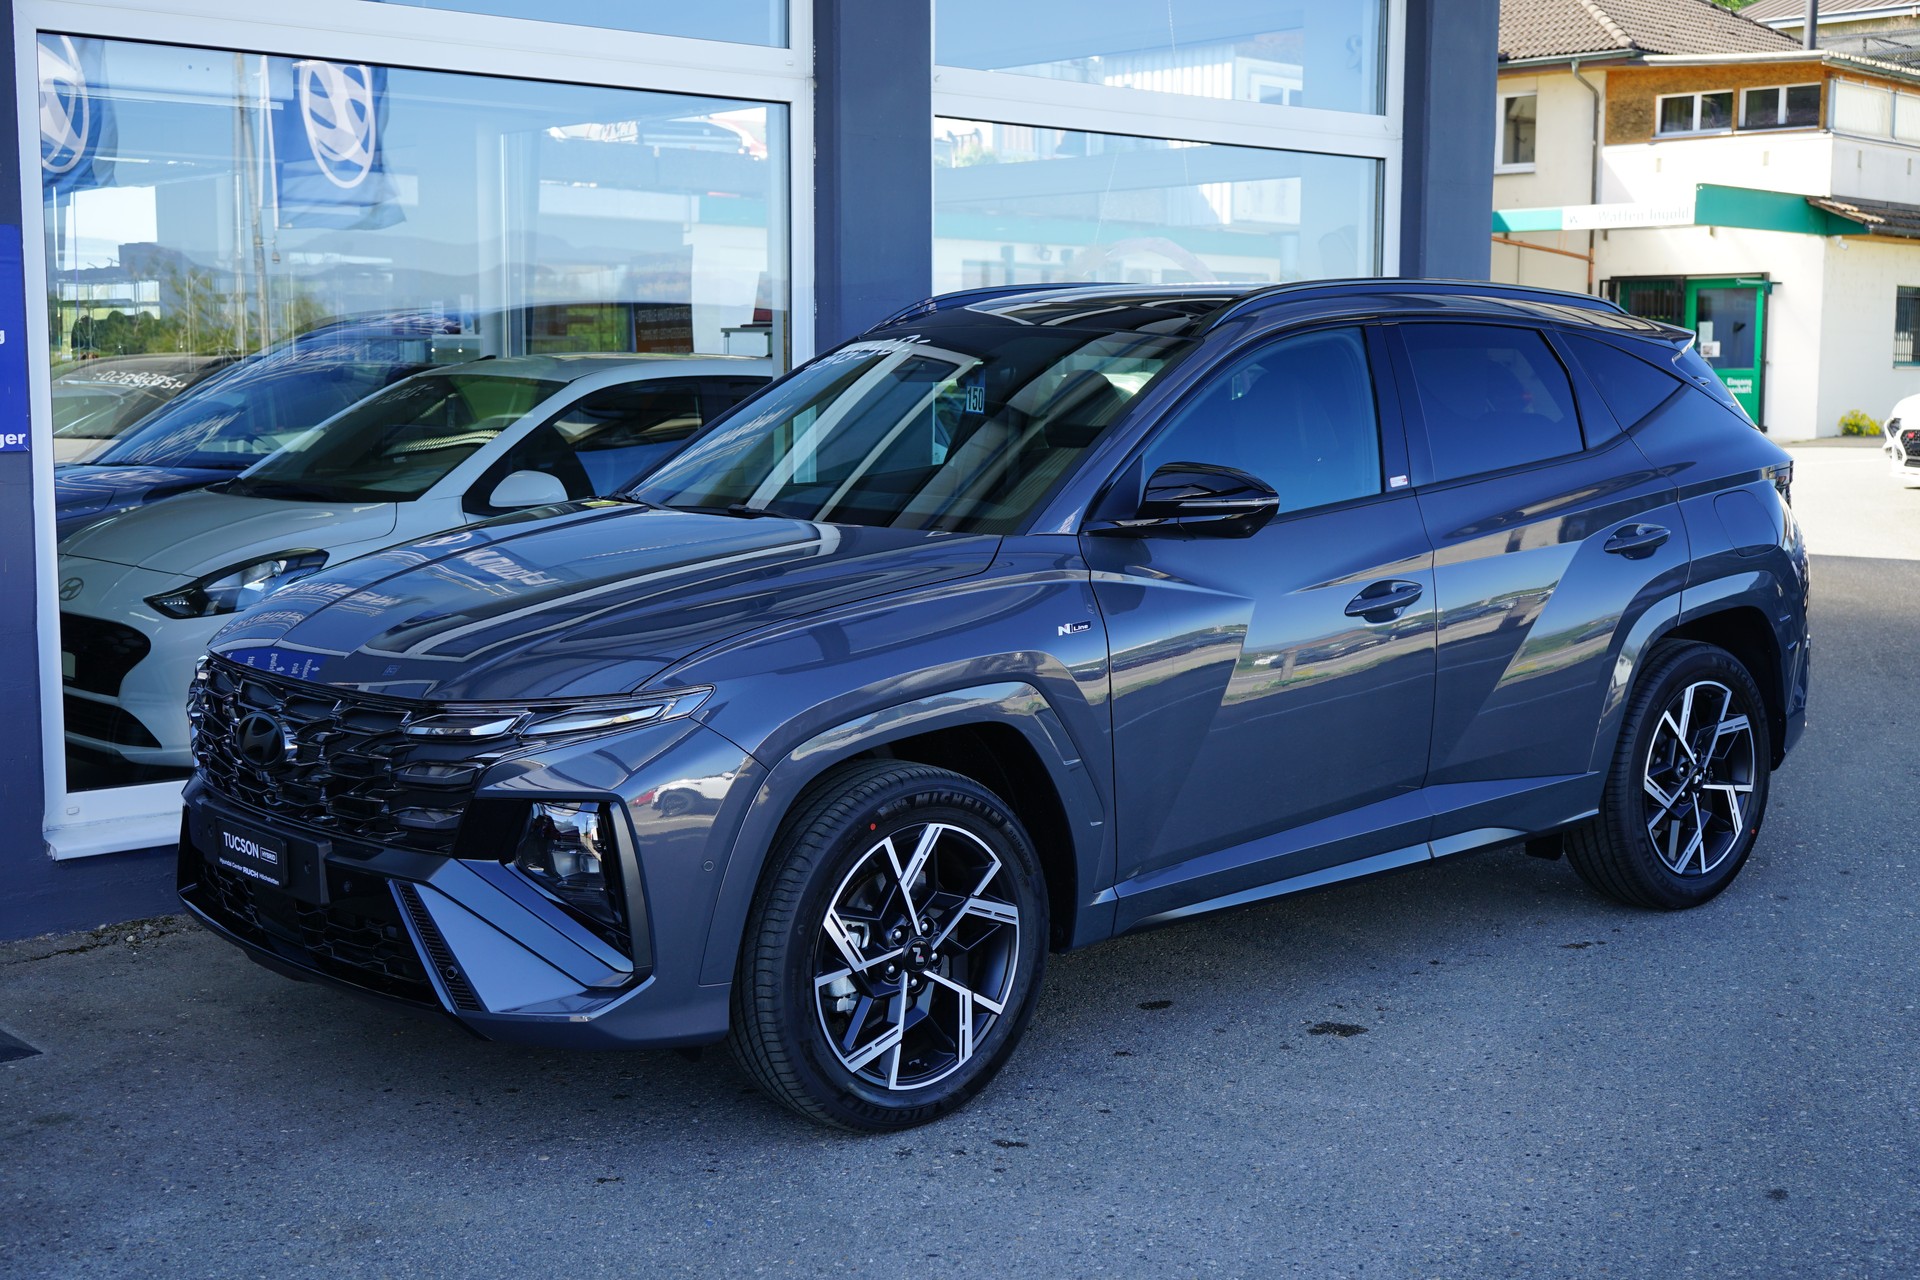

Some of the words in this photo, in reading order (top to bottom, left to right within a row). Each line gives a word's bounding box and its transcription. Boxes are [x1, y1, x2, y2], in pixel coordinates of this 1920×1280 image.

[967, 386, 984, 412] 150
[915, 791, 1003, 823] MICHELIN
[223, 831, 260, 859] TUCSON
[242, 866, 259, 879] RUCH
